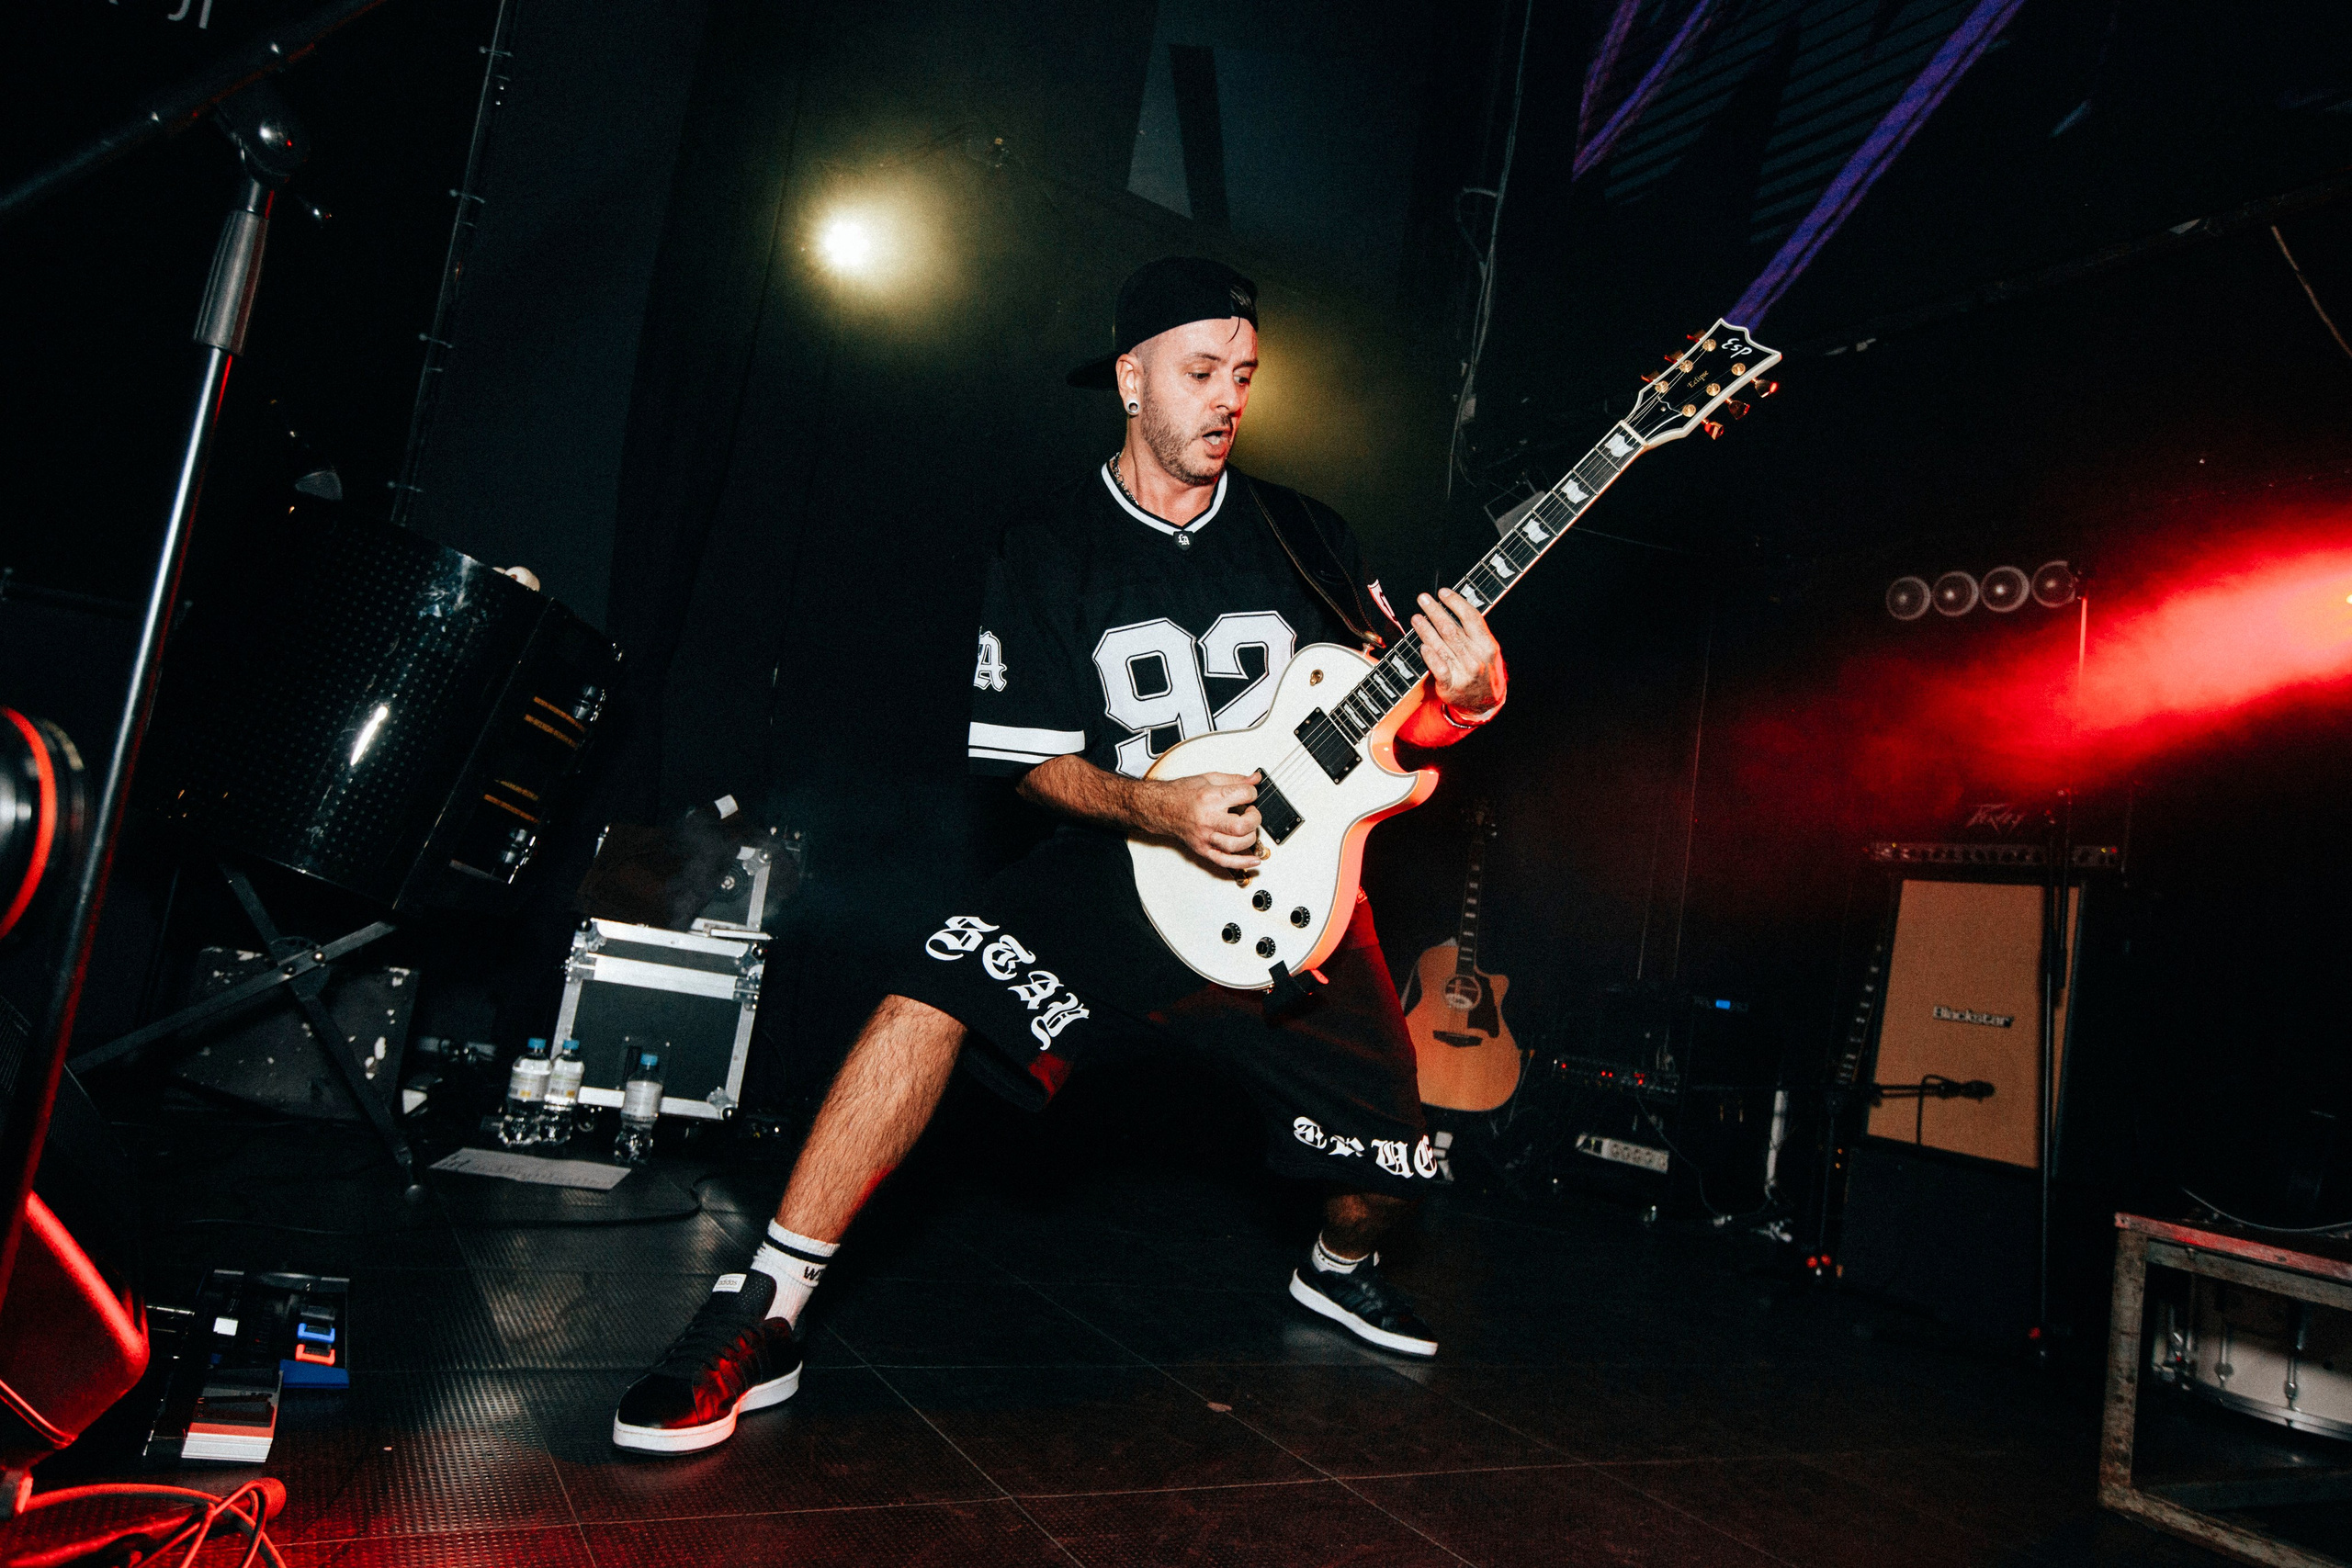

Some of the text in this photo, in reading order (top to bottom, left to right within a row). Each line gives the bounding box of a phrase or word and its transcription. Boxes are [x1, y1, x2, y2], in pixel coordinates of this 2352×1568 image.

[1687, 370, 1709, 389] Eclipse
[973, 626, 1008, 693] A
[1091, 610, 1297, 779] 92
[925, 916, 1091, 1051] STAY
[1932, 1005, 2014, 1029] Blackstar
[718, 1278, 738, 1286] adidas
